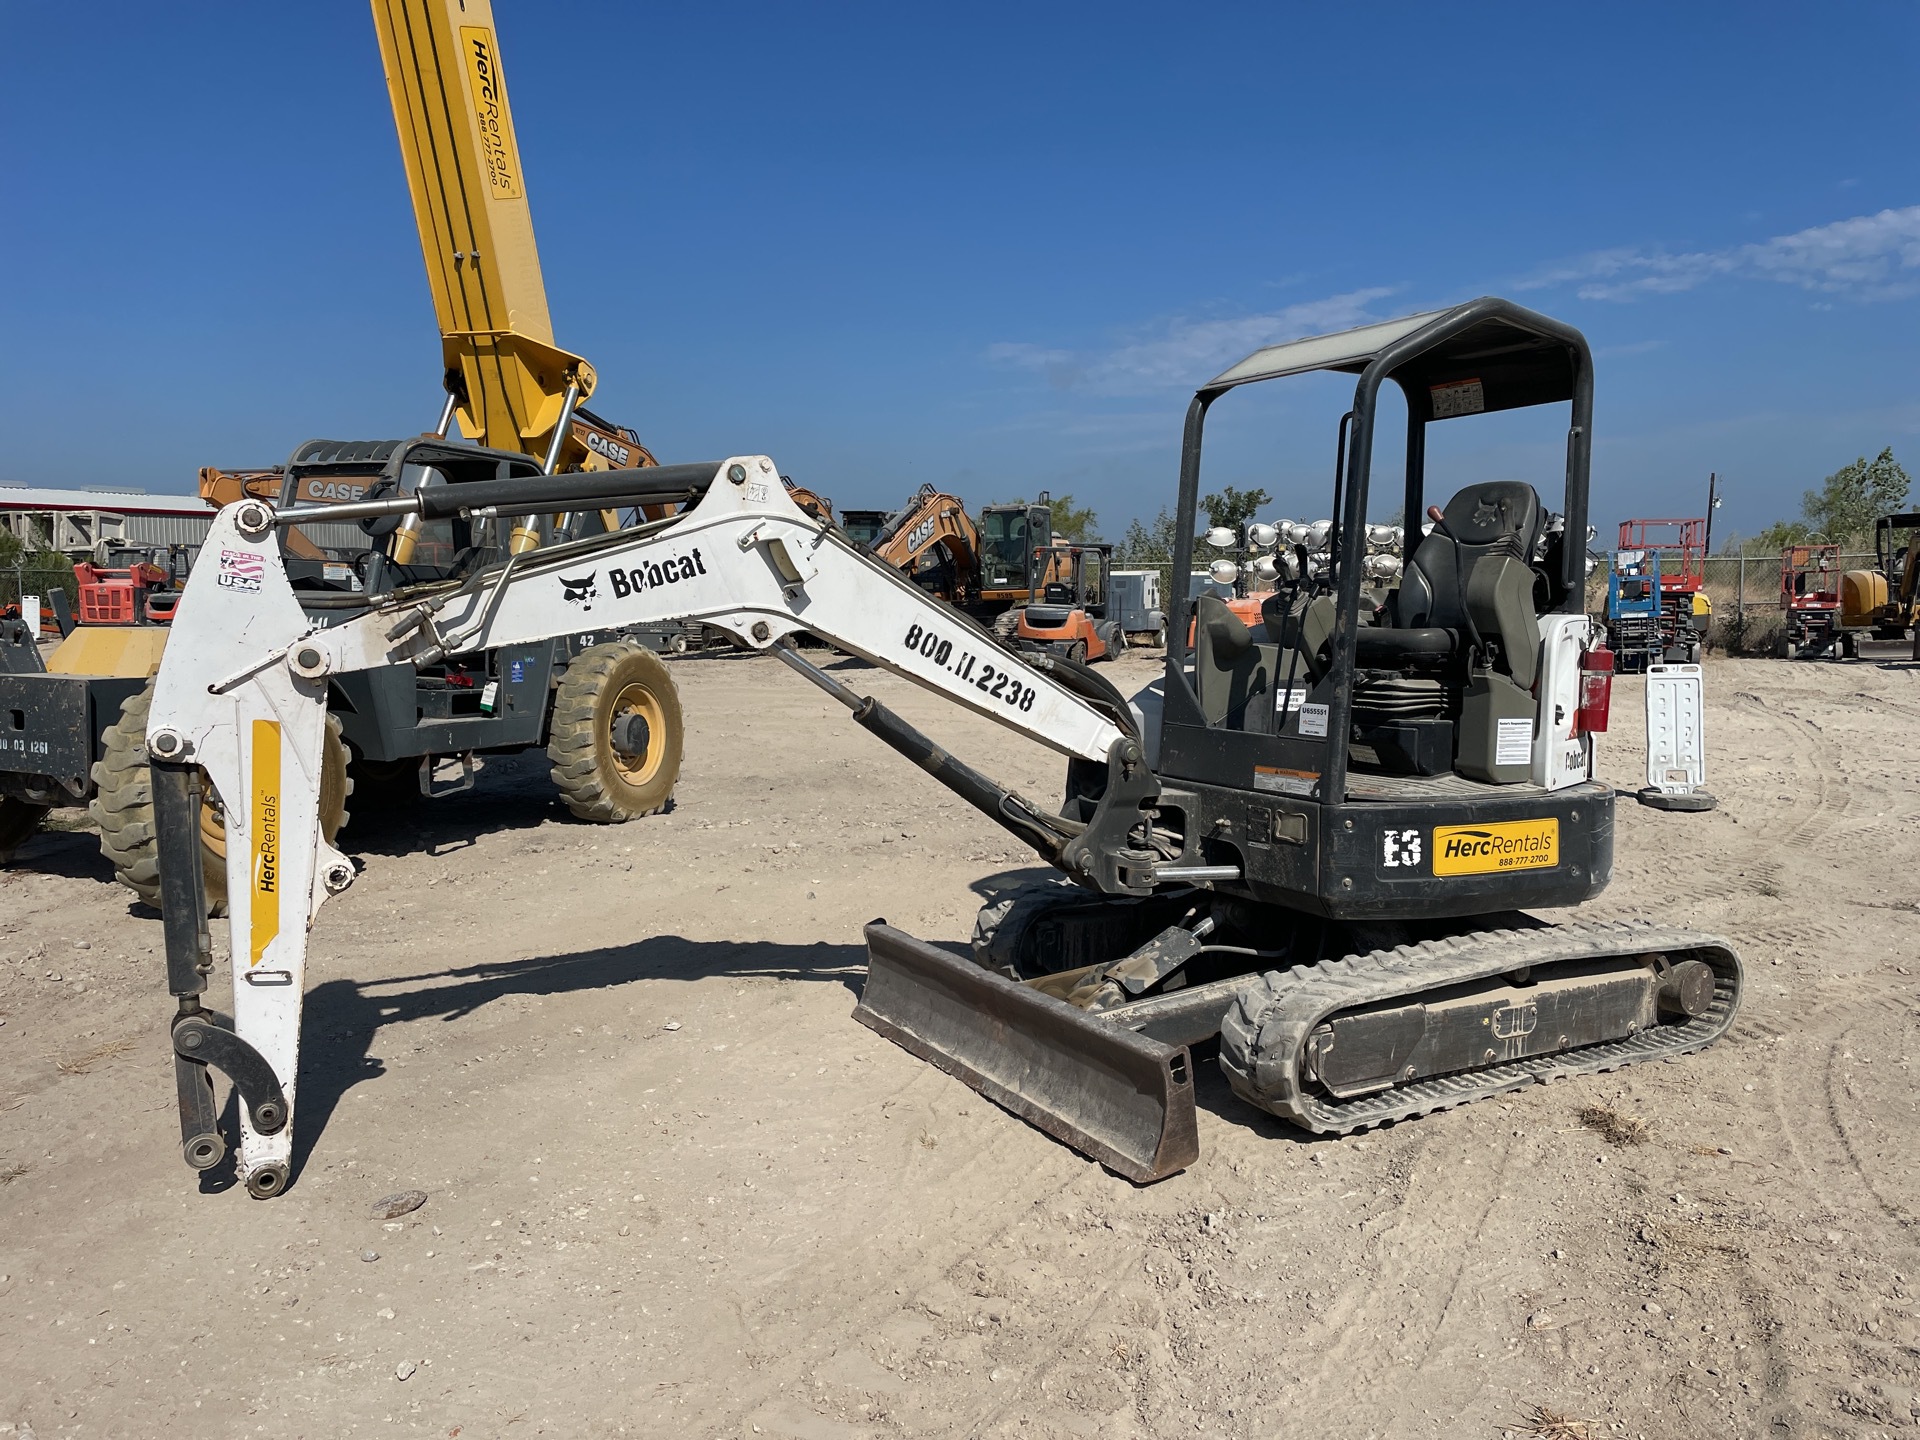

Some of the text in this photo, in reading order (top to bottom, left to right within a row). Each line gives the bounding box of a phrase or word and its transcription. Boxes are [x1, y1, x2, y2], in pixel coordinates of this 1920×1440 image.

[473, 39, 511, 190] HercRentals
[478, 112, 498, 186] 888-777-2700
[587, 432, 630, 467] CASE
[308, 480, 364, 501] CASE
[907, 514, 935, 554] CASE
[219, 575, 258, 590] USA
[608, 547, 707, 600] Bobcat
[579, 635, 595, 647] 42
[260, 795, 276, 892] HercRentals
[1445, 832, 1551, 858] HercRentals
[1499, 854, 1549, 866] 888-777-2700
